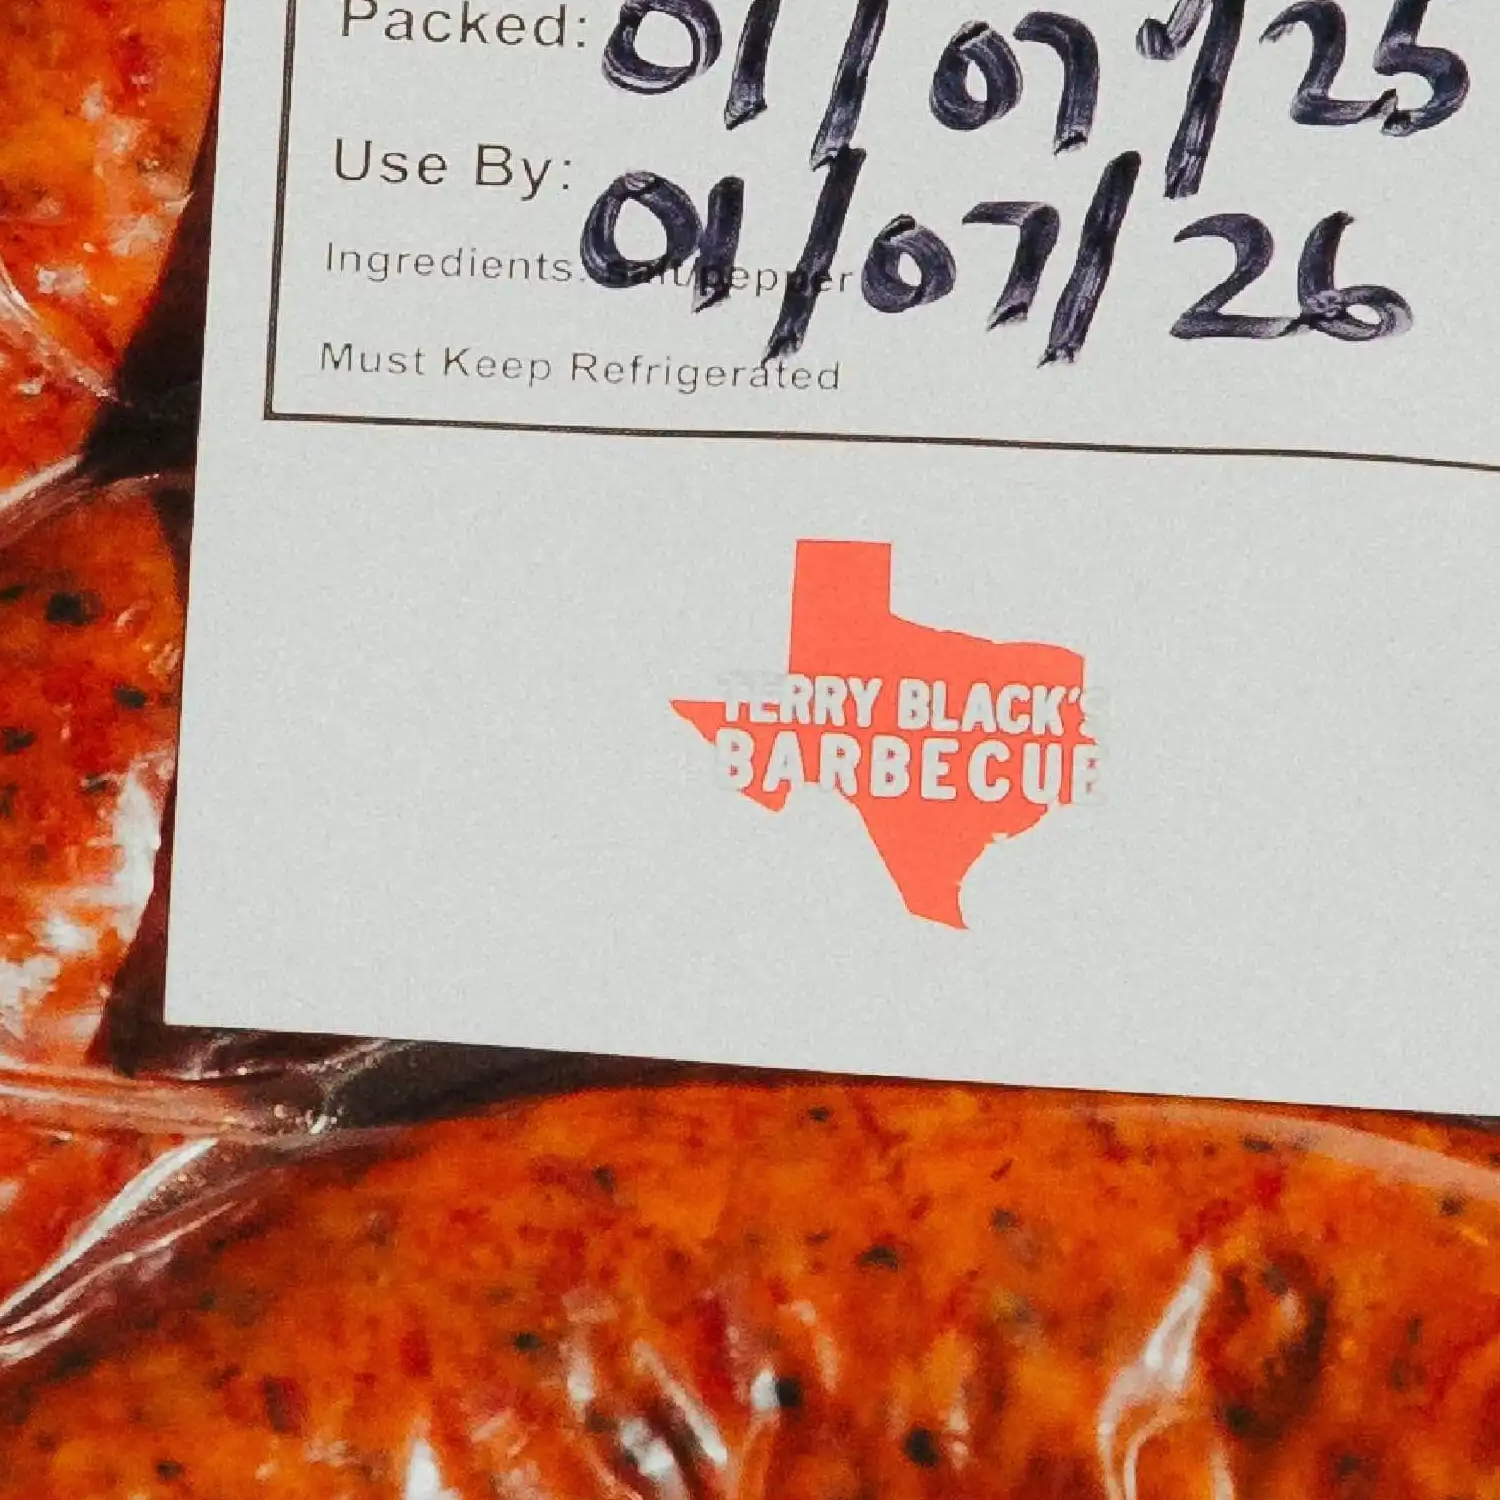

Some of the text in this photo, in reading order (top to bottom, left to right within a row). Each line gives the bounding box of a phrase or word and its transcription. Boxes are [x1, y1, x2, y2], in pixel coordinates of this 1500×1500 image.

[335, 137, 573, 201] Use By:
[579, 147, 1414, 368] 01/07/26
[320, 342, 841, 395] Must Keep Refrigerated
[714, 726, 1105, 806] BARBECUE
